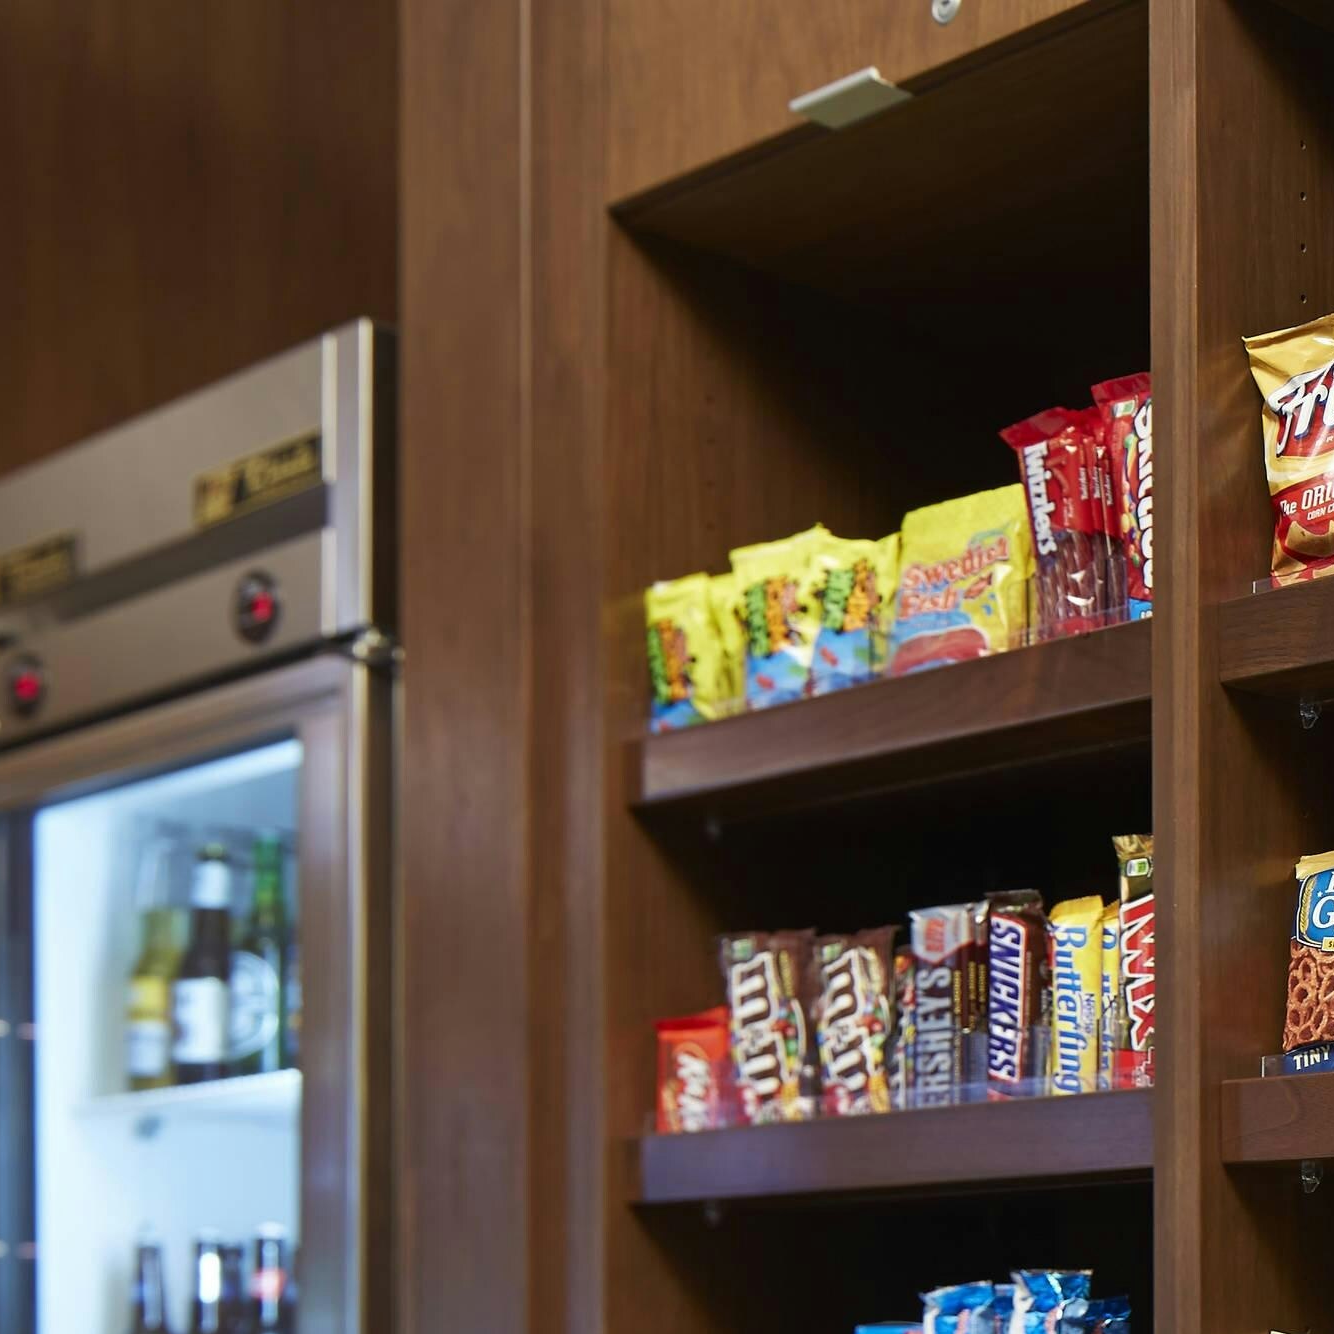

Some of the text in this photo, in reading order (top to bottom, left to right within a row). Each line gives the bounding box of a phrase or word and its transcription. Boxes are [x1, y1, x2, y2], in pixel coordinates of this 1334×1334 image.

[1280, 499, 1298, 516] The
[1307, 503, 1329, 520] CORN
[990, 916, 1023, 1079] SNICKERS
[1293, 1046, 1331, 1071] TINY
